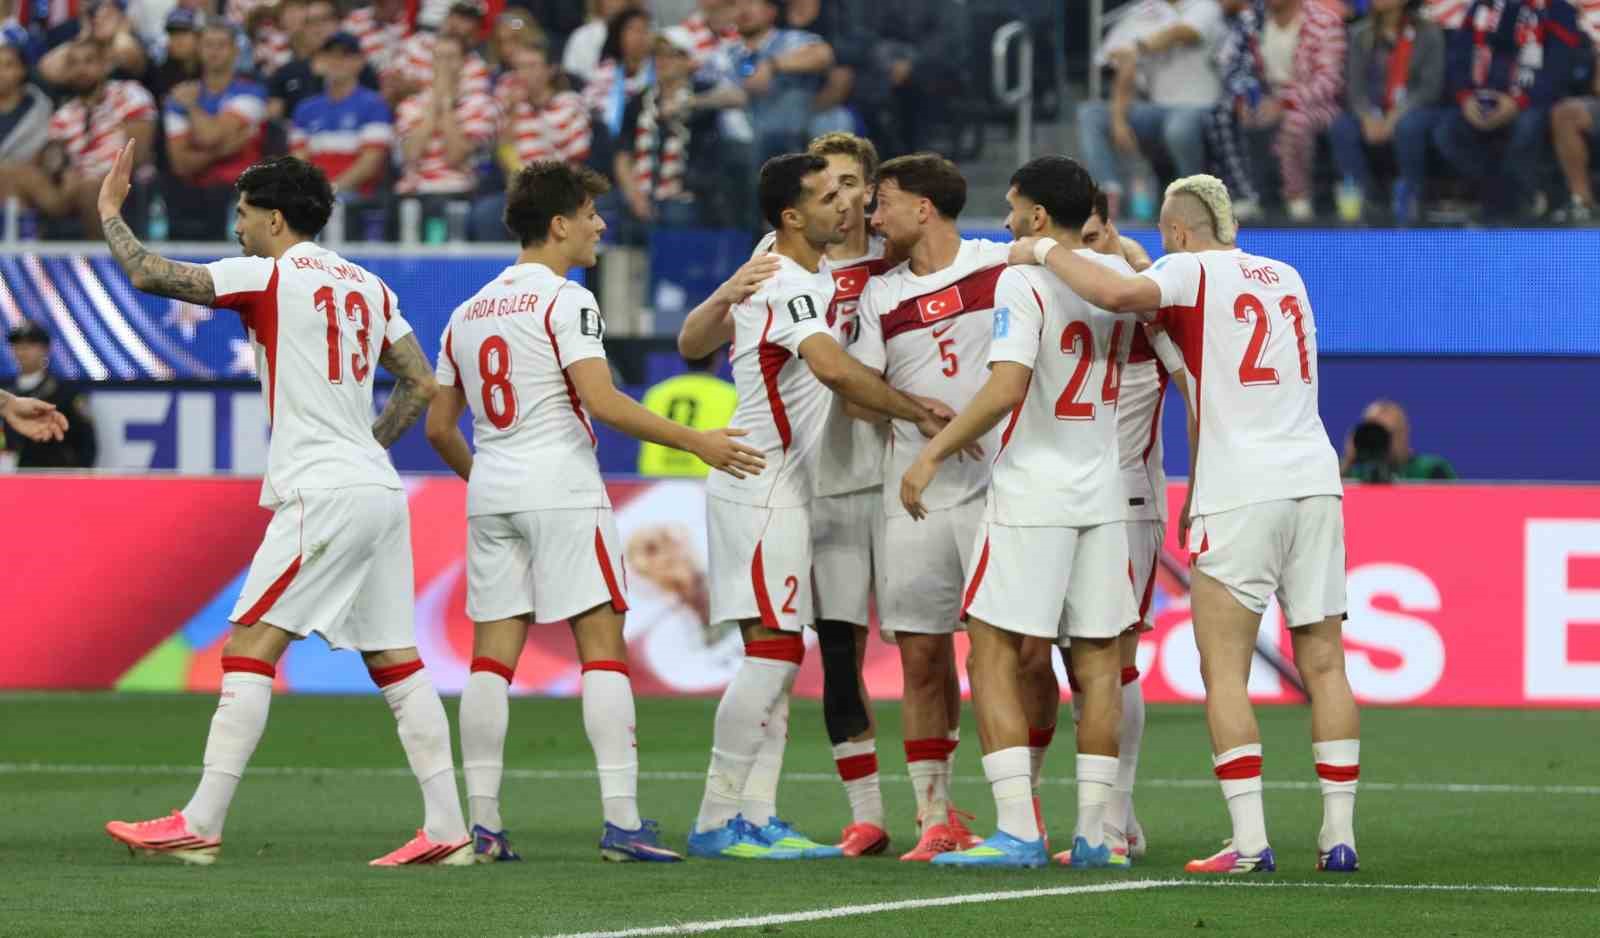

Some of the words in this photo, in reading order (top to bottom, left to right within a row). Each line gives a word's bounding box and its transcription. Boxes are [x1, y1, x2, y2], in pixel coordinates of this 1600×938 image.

[313, 286, 371, 386] 13
[463, 298, 496, 321] ARDA
[1233, 293, 1312, 387] 21
[479, 335, 520, 432] 8
[937, 338, 959, 378] 5
[1054, 319, 1124, 421] 24
[95, 391, 271, 473] FI
[781, 575, 798, 614] 2
